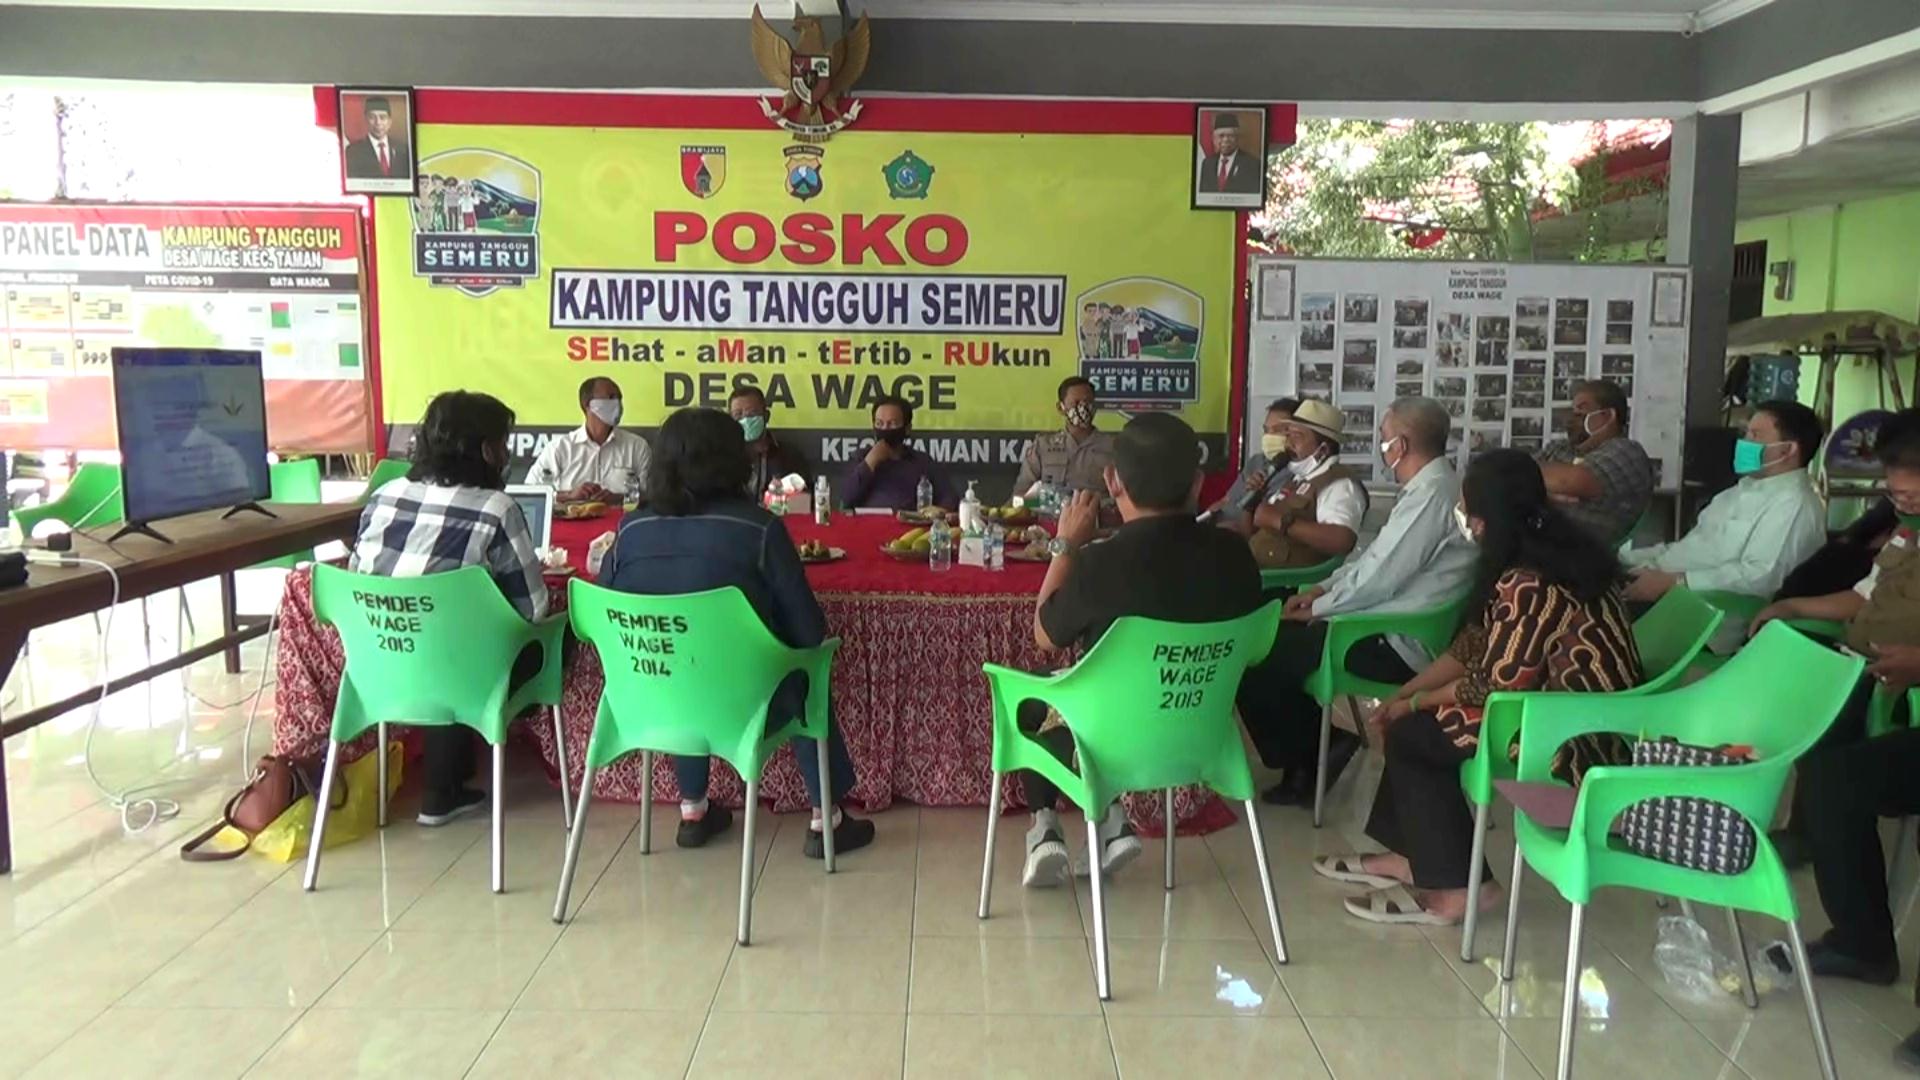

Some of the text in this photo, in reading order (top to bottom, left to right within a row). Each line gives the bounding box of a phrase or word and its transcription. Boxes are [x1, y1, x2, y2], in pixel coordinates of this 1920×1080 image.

[2, 226, 149, 257] PANEL DATA
[162, 226, 341, 249] KAMPUNG TANGGUH
[425, 241, 529, 250] KAMPUNG TANGGUH
[654, 211, 969, 266] POSKO
[163, 249, 322, 269] DESA WAGE KEC. TAMAN
[424, 250, 529, 267] SEMERU
[144, 275, 214, 286] PETA COVID-19
[270, 277, 330, 288] DATA WARGA
[558, 278, 1060, 327] KAMPUNG TANGGUH SEMERU
[567, 336, 665, 362] SEhat
[697, 338, 785, 364] aMan
[818, 340, 911, 366] tErtib
[944, 341, 1050, 367] RUkun
[1089, 367, 1190, 376] KAMPUNG TANGGUH
[811, 374, 957, 411] WAGE
[1089, 376, 1189, 392] SEMERU
[903, 438, 990, 462] AMAN
[353, 590, 435, 613] PEMDES
[366, 612, 423, 633] WAGE
[606, 607, 689, 633] PEMDES
[377, 634, 416, 653] 2013
[618, 632, 675, 655] WAGE
[1152, 639, 1235, 663] PEMDES
[630, 656, 672, 677] 2014
[1160, 664, 1217, 686] WAGE
[1159, 689, 1203, 709] 2013
